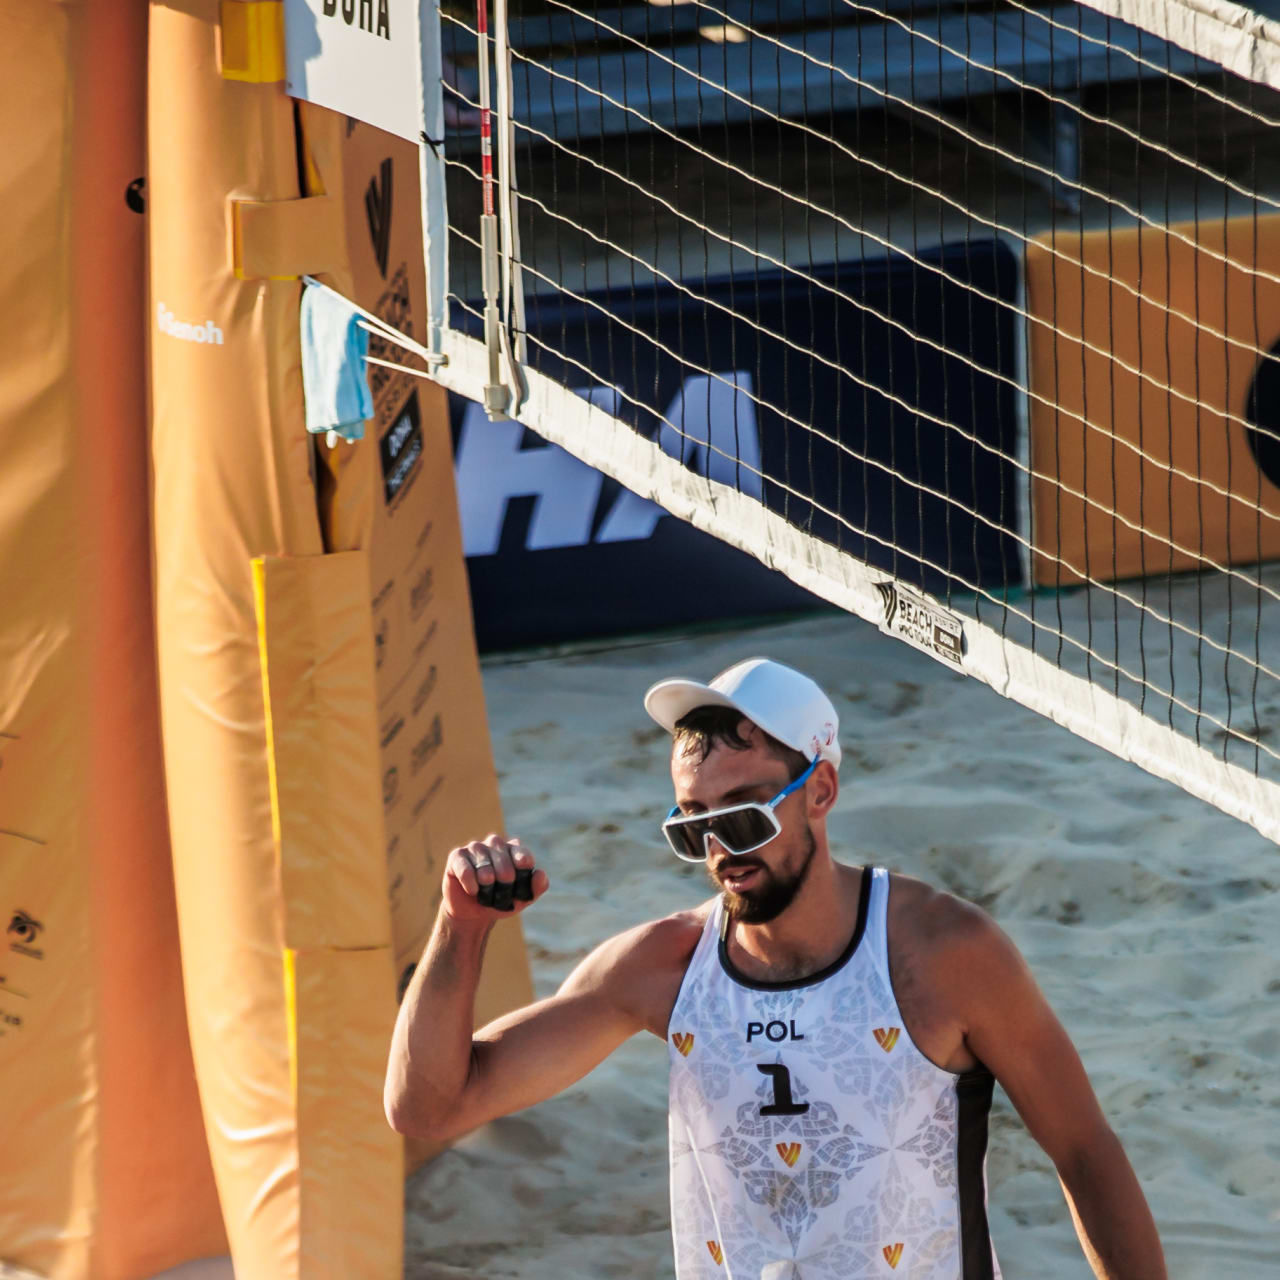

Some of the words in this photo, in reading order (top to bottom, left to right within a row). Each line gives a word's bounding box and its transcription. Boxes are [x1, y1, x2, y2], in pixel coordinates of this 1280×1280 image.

[899, 599, 933, 635] BEACH
[746, 1018, 806, 1044] POL
[756, 1061, 811, 1117] 1
